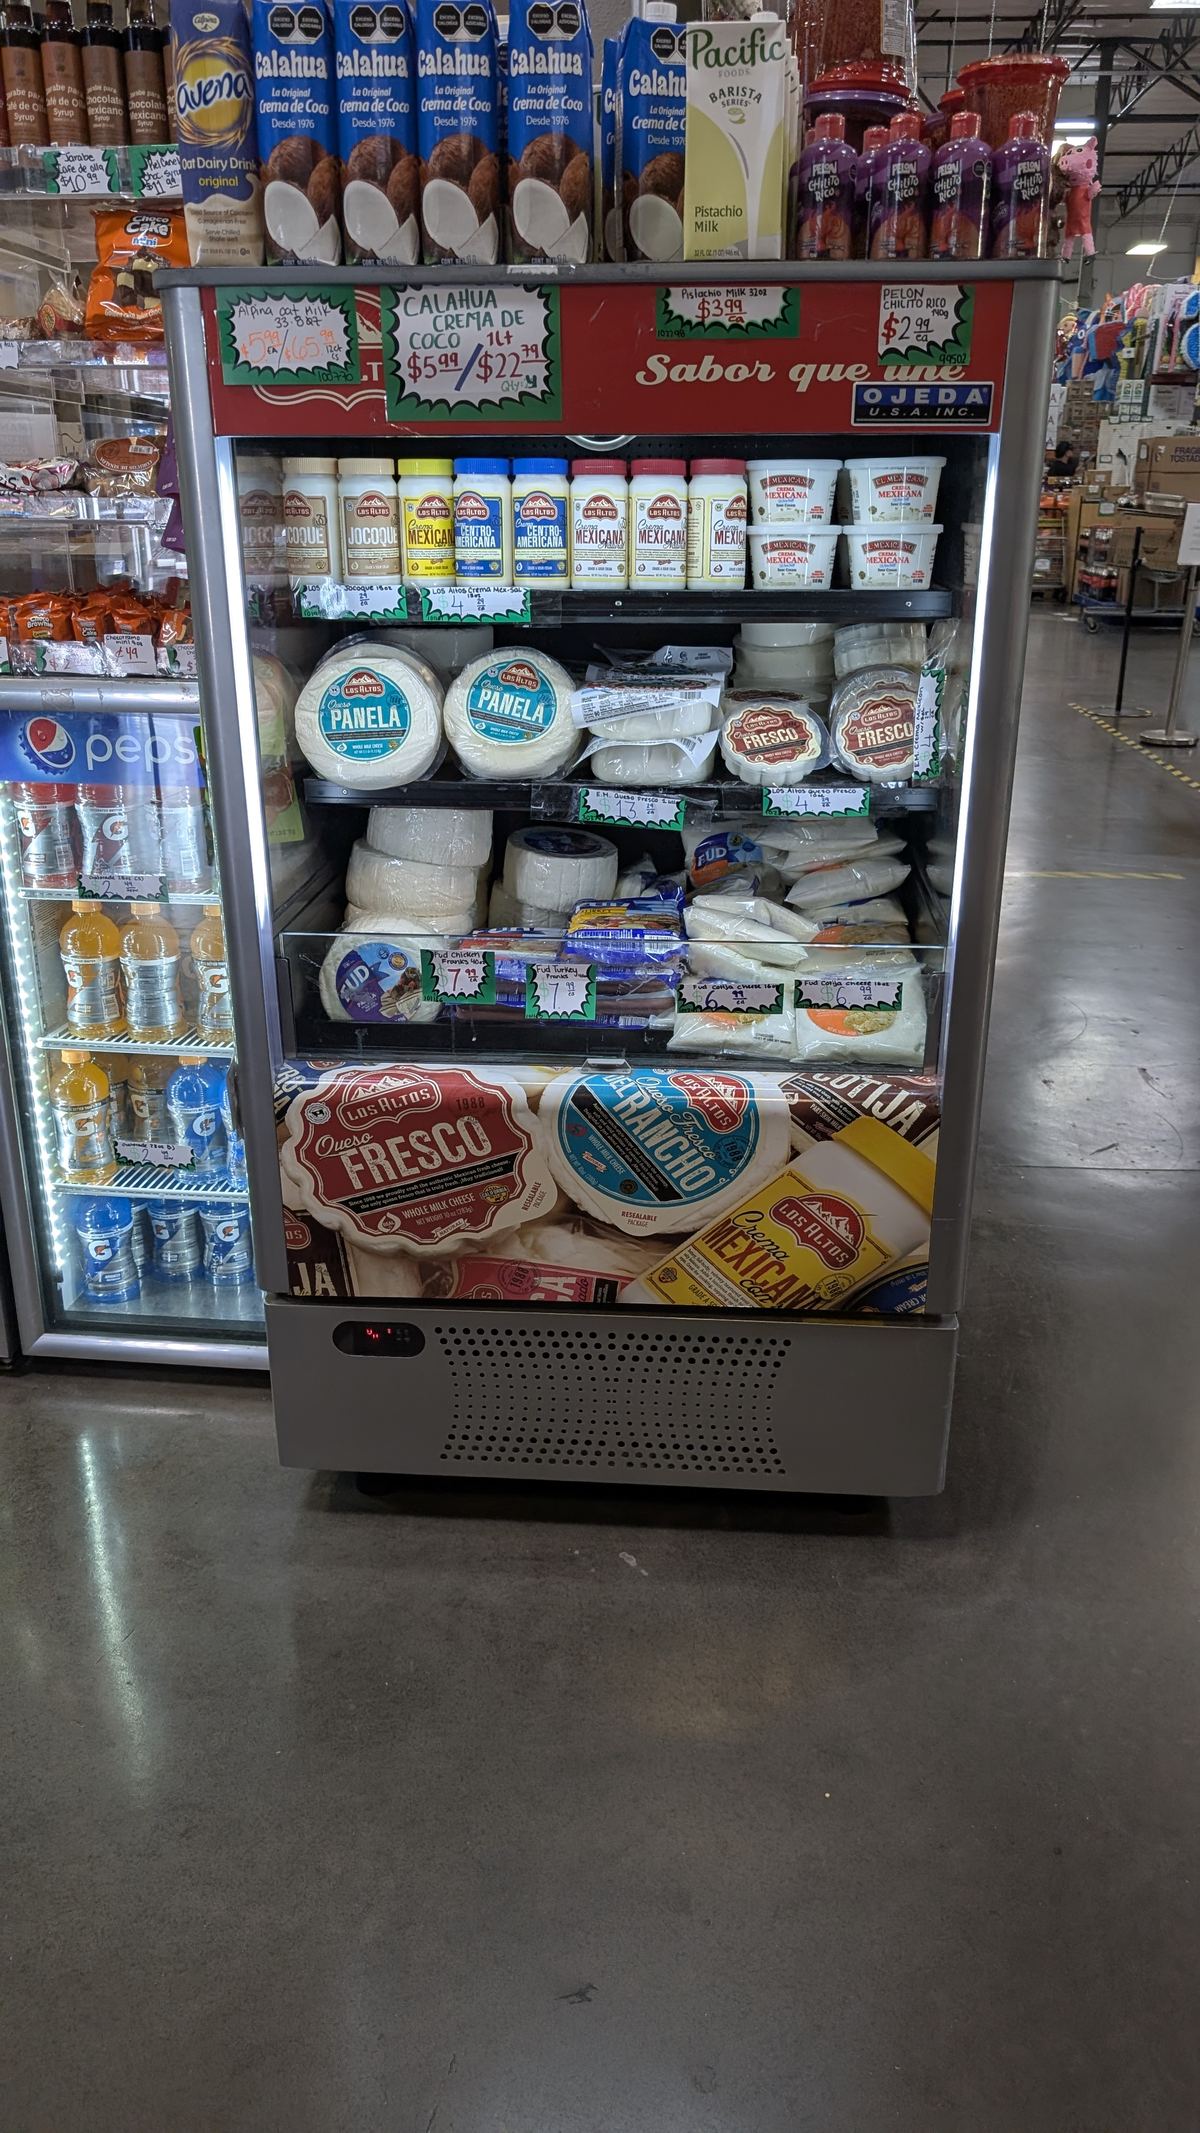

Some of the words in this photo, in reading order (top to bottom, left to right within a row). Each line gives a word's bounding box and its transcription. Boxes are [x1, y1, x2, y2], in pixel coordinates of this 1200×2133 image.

[687, 28, 786, 71] Pacific
[255, 49, 328, 80] Calahua
[336, 49, 408, 79] Calahua
[418, 47, 491, 78] Calahua
[510, 46, 583, 77] Calahua
[718, 69, 750, 78] FOODS
[272, 88, 281, 97] La
[282, 87, 311, 99] Original
[352, 87, 361, 97] La
[362, 87, 391, 99] Original
[435, 86, 444, 95] La
[445, 85, 474, 97] Original
[527, 85, 536, 94] La
[537, 85, 567, 97] Original
[709, 86, 762, 104] BARISTA
[260, 100, 288, 114] Crema
[290, 99, 303, 112] de
[305, 99, 330, 115] Coco
[340, 99, 369, 114] Crema
[371, 98, 383, 112] de
[386, 99, 410, 113] Coco
[421, 98, 450, 112] Crema
[453, 97, 466, 111] de
[468, 97, 491, 112] Coco
[513, 97, 544, 111] Crema
[546, 96, 559, 109] de
[561, 96, 583, 111] Coco
[649, 106, 658, 114] La
[722, 99, 749, 108] SERIES
[14, 112, 35, 122] Syrup
[53, 108, 74, 119] Syrup
[94, 115, 110, 124] Syrup
[526, 116, 550, 126] Desde
[552, 115, 569, 126] 1976
[272, 118, 295, 129] Desde
[298, 118, 315, 129] 1976
[352, 118, 376, 128] Desde
[378, 117, 395, 128] 1976
[434, 116, 458, 126] Desde
[460, 116, 477, 126] 1976
[632, 116, 664, 130] Crema
[665, 116, 679, 131] de
[647, 134, 671, 145] Desde
[78, 162, 88, 173] de
[182, 159, 196, 171] Oat
[197, 157, 228, 171] Dairy
[230, 157, 256, 170] Drink
[199, 176, 238, 189] original
[132, 215, 169, 223] Choco
[694, 205, 743, 219] Pistachio
[126, 222, 168, 236] Cake
[694, 220, 719, 232] Milk
[132, 236, 157, 246] mini
[681, 288, 721, 300] Pistachio
[726, 289, 745, 298] Milk
[749, 288, 767, 297] 32oz
[883, 287, 924, 300] PELON
[403, 288, 498, 317] CALAHUA
[883, 298, 923, 310] CHILITO
[926, 298, 947, 309] RICO
[238, 306, 272, 319] Alpina
[279, 305, 299, 317] oat
[305, 304, 331, 315] Milk
[433, 311, 494, 333] CREMA
[501, 310, 525, 327] DE
[409, 332, 461, 350] COCO
[635, 353, 776, 386] Sabor
[788, 361, 871, 393] que
[863, 387, 984, 405] OJEDA
[868, 407, 930, 417] U.S.A.
[935, 407, 975, 417] INC.
[765, 491, 808, 500] MEXICANA
[878, 490, 923, 498] MEXICANA
[370, 506, 390, 516] ALTOS
[431, 508, 450, 516] ALTOS
[534, 507, 555, 516] ALTOS
[597, 508, 616, 517] ALTOS
[661, 507, 680, 517] ALTOS
[348, 527, 398, 547] JOCOQUE
[460, 525, 495, 538] CENTRO-
[526, 525, 562, 537] CENTRO-
[576, 529, 624, 544] MEXICANA
[639, 529, 686, 544] MEXICANA
[517, 536, 563, 548] AMERICANA
[767, 556, 809, 564] MEXICANA
[866, 556, 910, 564] MEXICANA
[467, 586, 492, 595] Crema
[502, 672, 515, 682] LOS
[515, 674, 537, 688] ALTOS
[359, 685, 382, 693] ALTOS
[477, 688, 545, 724] PANELA
[330, 705, 402, 730] PANELA
[743, 728, 799, 749] FRESCO
[857, 722, 913, 748] FRESCO
[86, 733, 196, 773] peps
[697, 847, 727, 869] FUD
[536, 965, 550, 973] Fud
[553, 965, 578, 976] Turkey
[341, 965, 370, 1003] FUD
[347, 1102, 379, 1121] LOS
[379, 1088, 432, 1112] ALTOS
[456, 1097, 485, 1112] 1988
[677, 1074, 700, 1092] LOS
[696, 1084, 733, 1127] ALTOS
[812, 1073, 927, 1137] COTIJA
[635, 1075, 674, 1114] Queso
[670, 1111, 715, 1161] Fresco
[315, 1132, 375, 1159] Queso
[612, 1091, 717, 1192] RANCHO
[339, 1115, 493, 1190] FRESCO
[724, 1140, 743, 1163] 1988
[521, 1181, 543, 1212] RESEALABLE
[401, 1204, 431, 1219] WHOLE
[430, 1199, 449, 1213] MILK
[449, 1192, 476, 1207] CHEESE
[416, 1217, 426, 1225] NET
[621, 1211, 658, 1222] RESEALABLE
[626, 1219, 649, 1228] PACKAGE
[731, 1210, 791, 1263] Crema
[778, 1202, 809, 1228] LOS
[803, 1221, 850, 1264] ALTOS
[509, 1266, 530, 1289] 1988
[688, 1283, 705, 1300] GRADE
[703, 1296, 710, 1304] A
[739, 1279, 772, 1304] con
